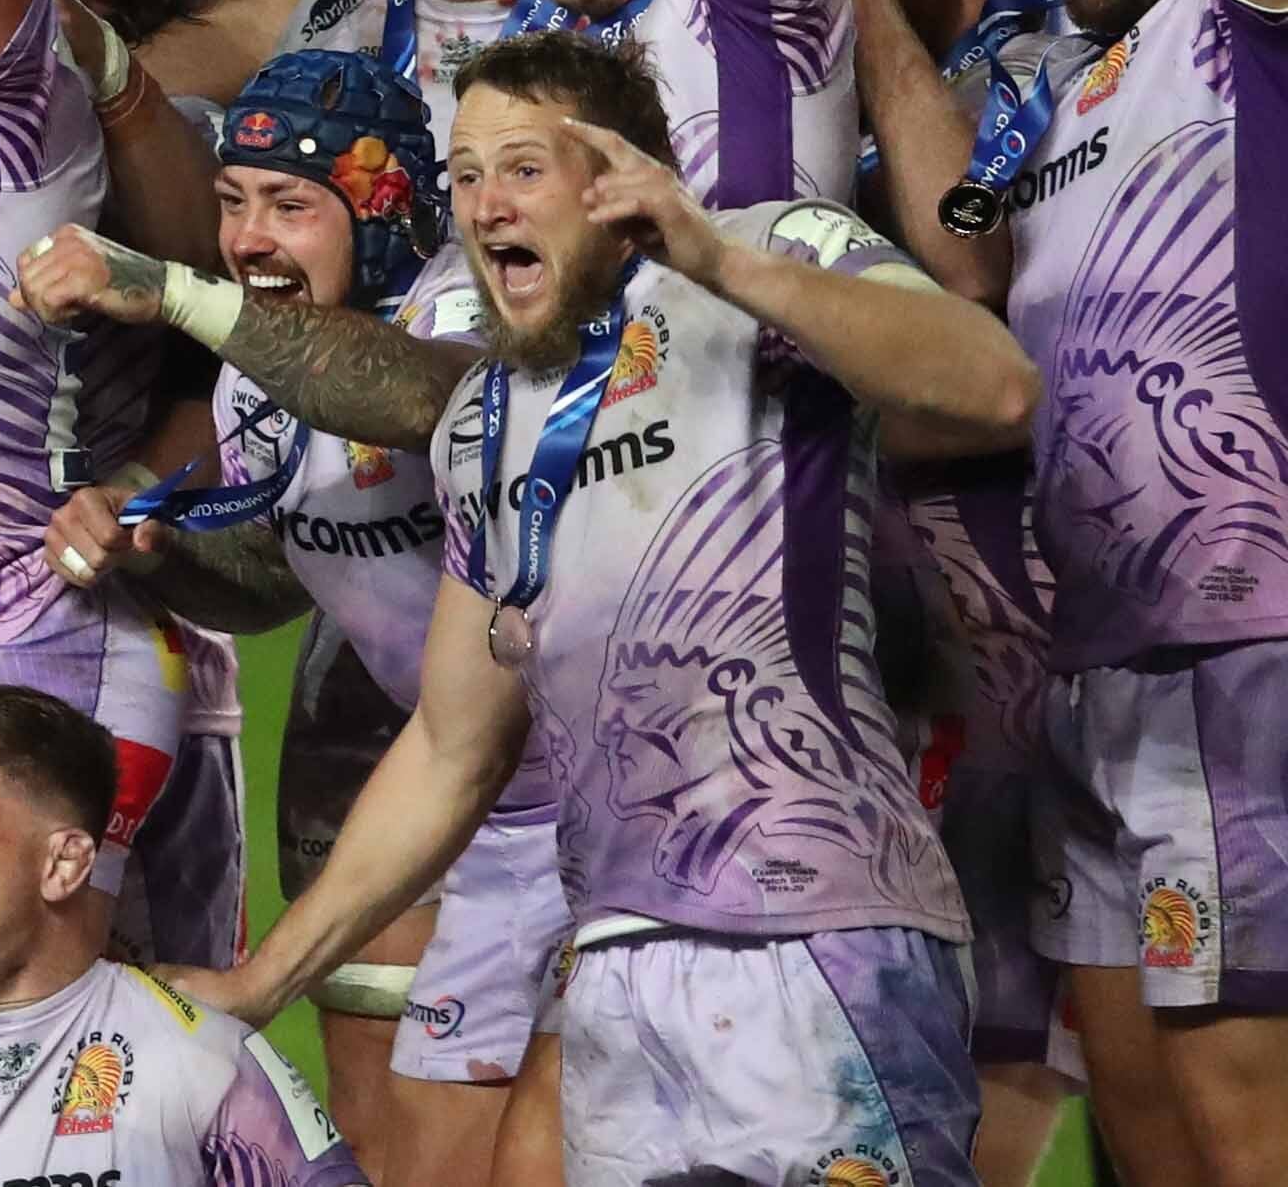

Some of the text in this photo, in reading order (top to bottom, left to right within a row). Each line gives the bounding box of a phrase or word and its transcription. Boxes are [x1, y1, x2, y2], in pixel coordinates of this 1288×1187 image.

[1012, 125, 1111, 210] omms
[642, 304, 671, 362] RUGBY
[292, 501, 447, 558] comms
[1176, 877, 1211, 948] RUGBY
